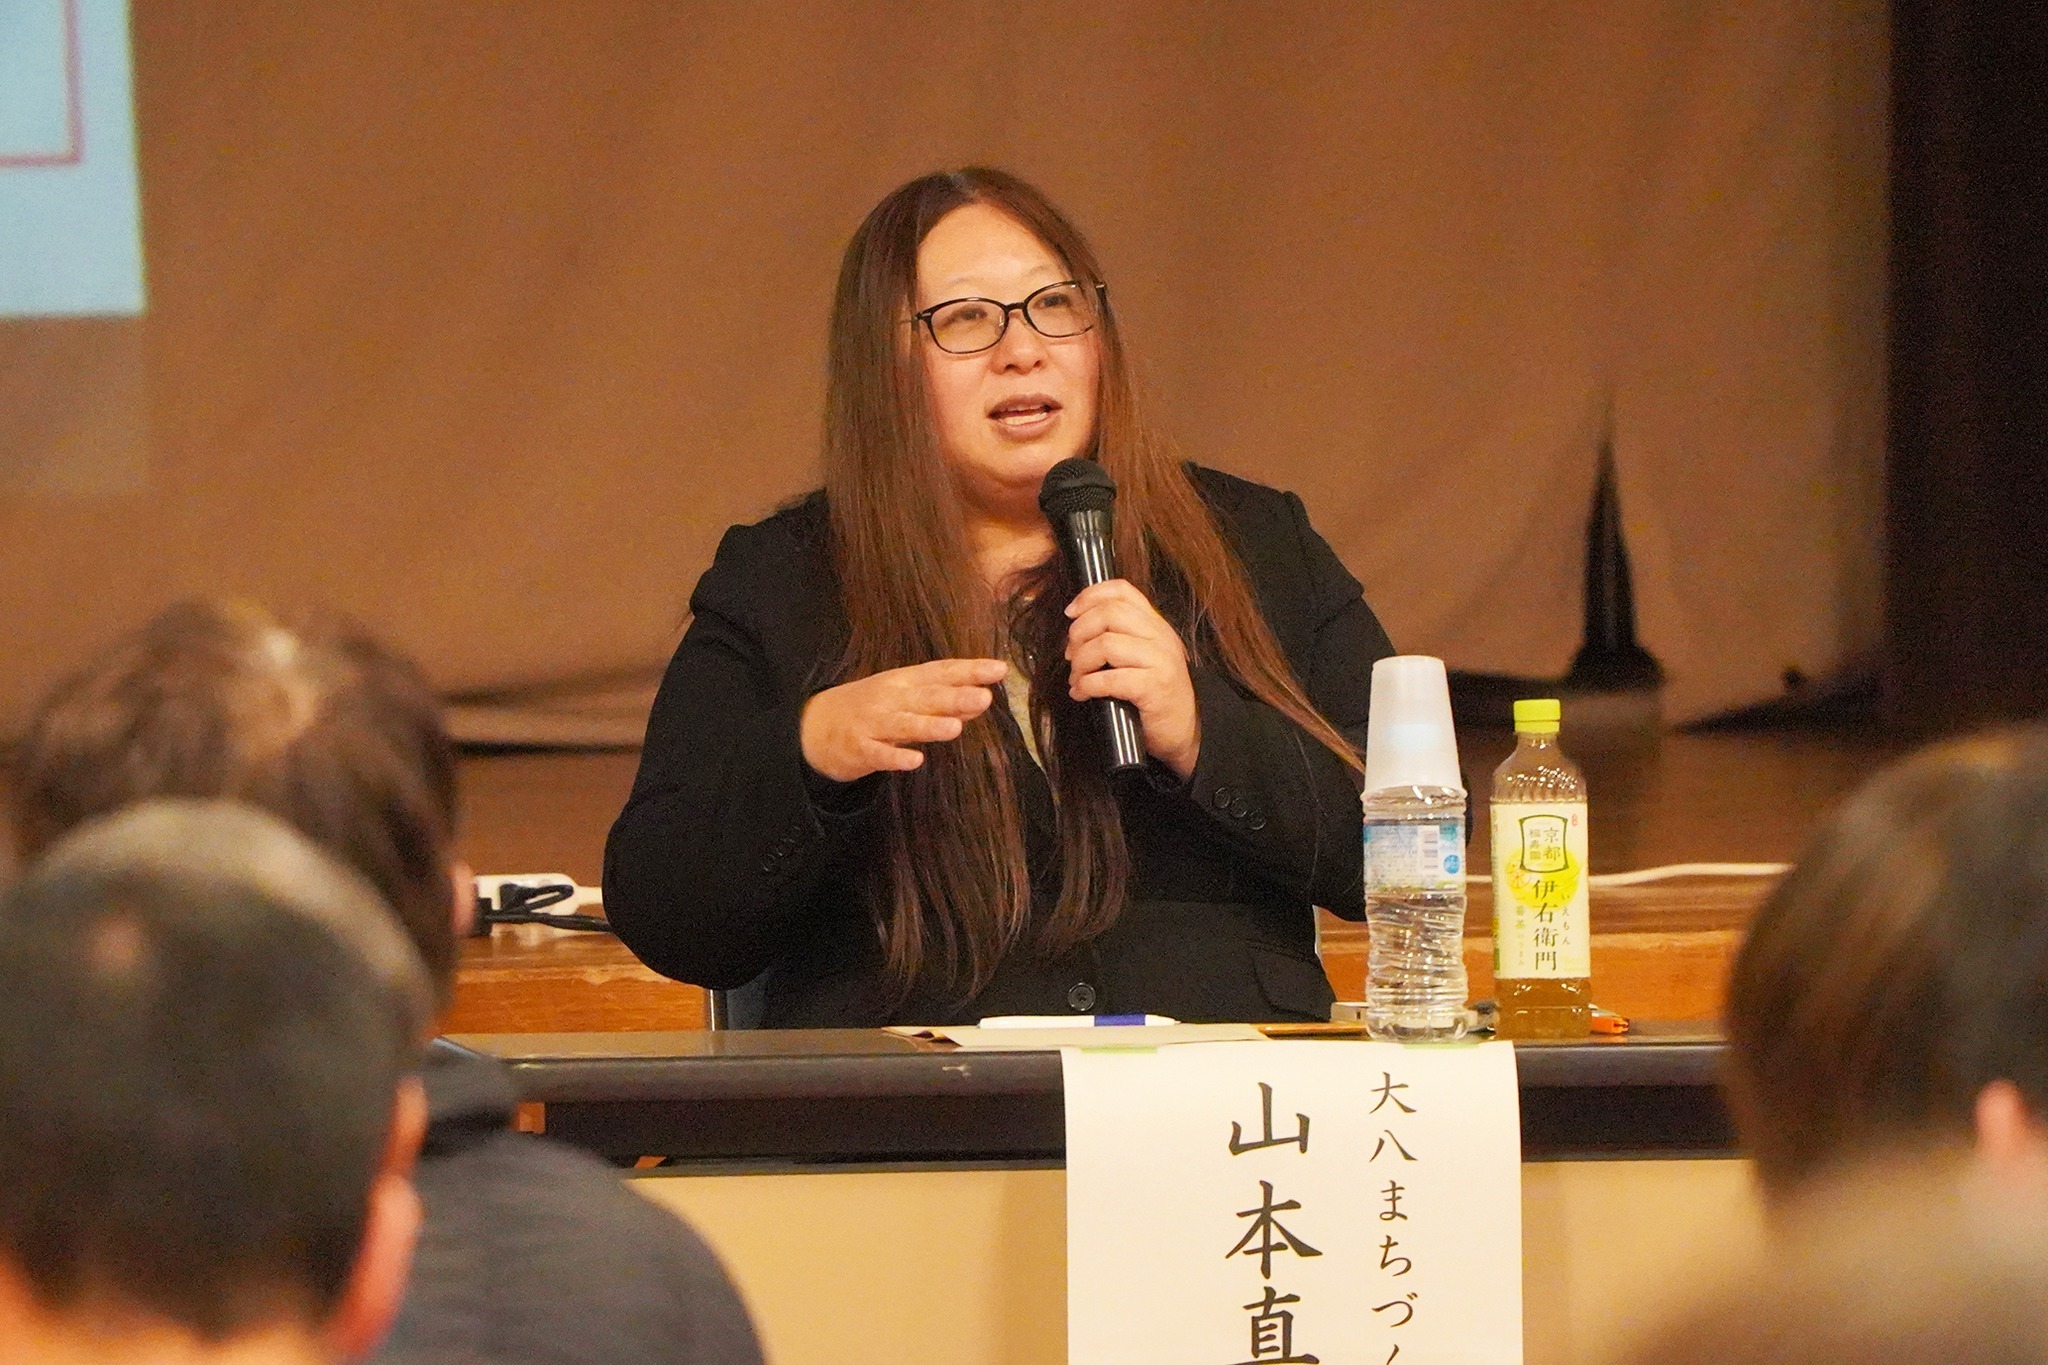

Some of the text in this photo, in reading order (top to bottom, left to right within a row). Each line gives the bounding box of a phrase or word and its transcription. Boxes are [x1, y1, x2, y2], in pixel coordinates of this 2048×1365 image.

[1543, 827, 1561, 861] 京都
[1532, 879, 1559, 971] 伊右衛門
